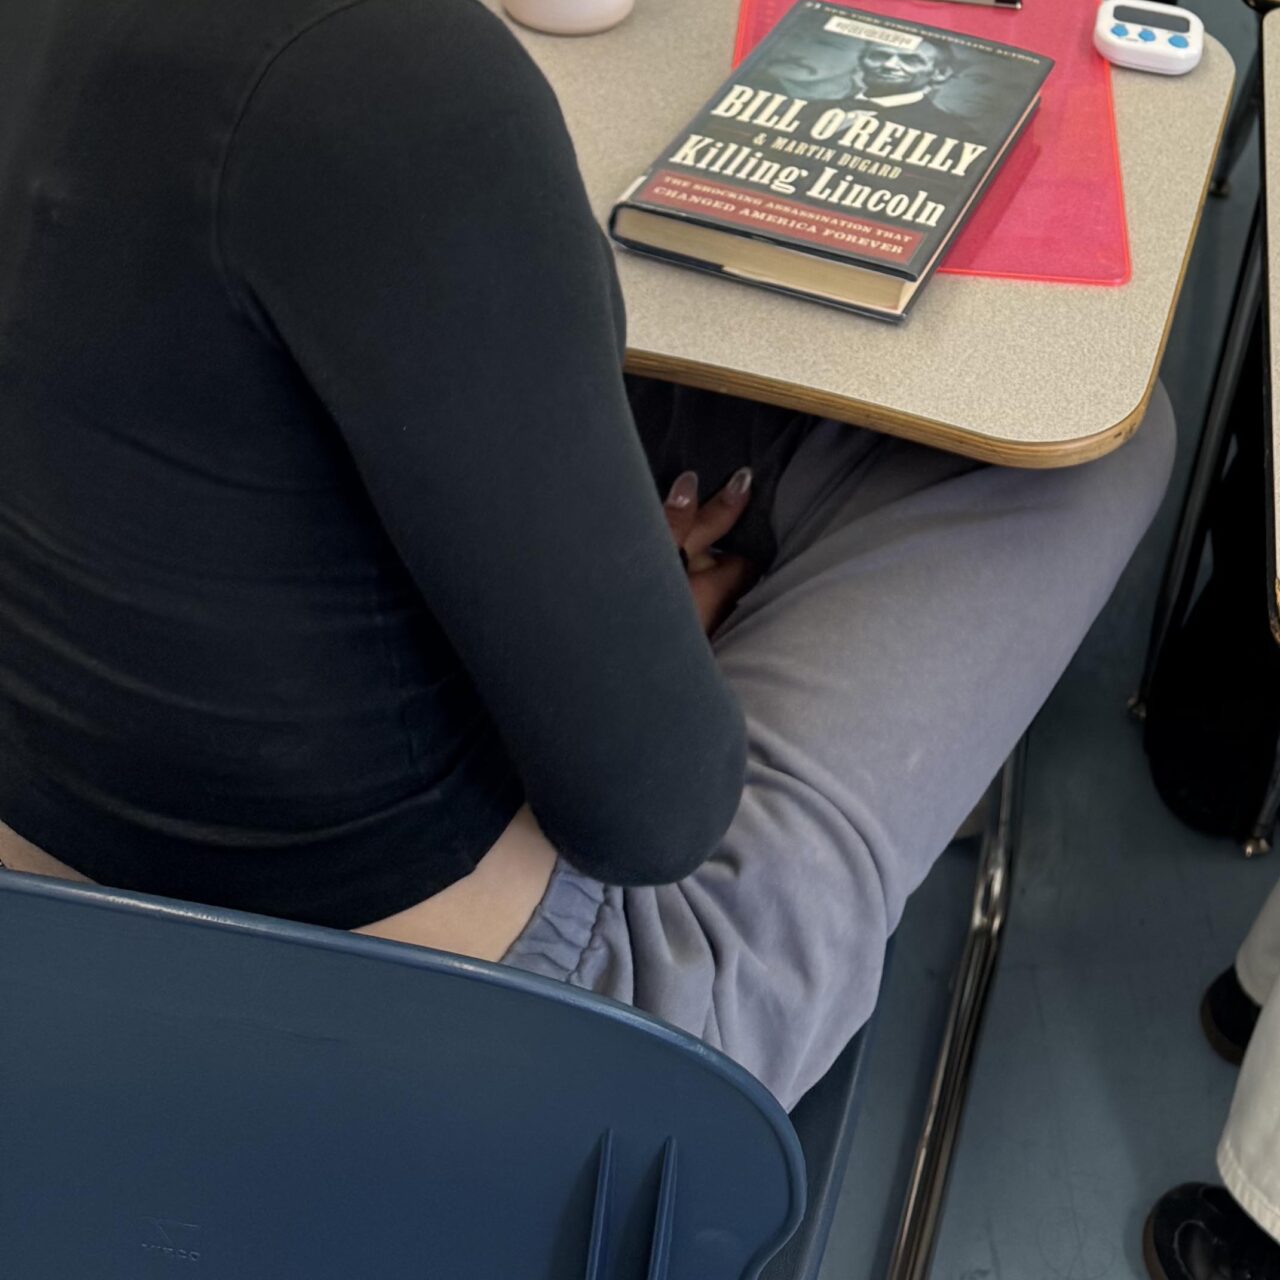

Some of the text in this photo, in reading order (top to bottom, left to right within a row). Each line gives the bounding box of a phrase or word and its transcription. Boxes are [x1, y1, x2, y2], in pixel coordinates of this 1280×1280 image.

[710, 84, 987, 177] BILL O'REILLY
[752, 132, 903, 181] & MARTIN DUGARD
[664, 175, 913, 243] THE SHOCKING ASSASSINATION THAT
[668, 134, 946, 229] Killing Lincoln
[653, 186, 904, 254] CHANGED AMERICA FOREVER
